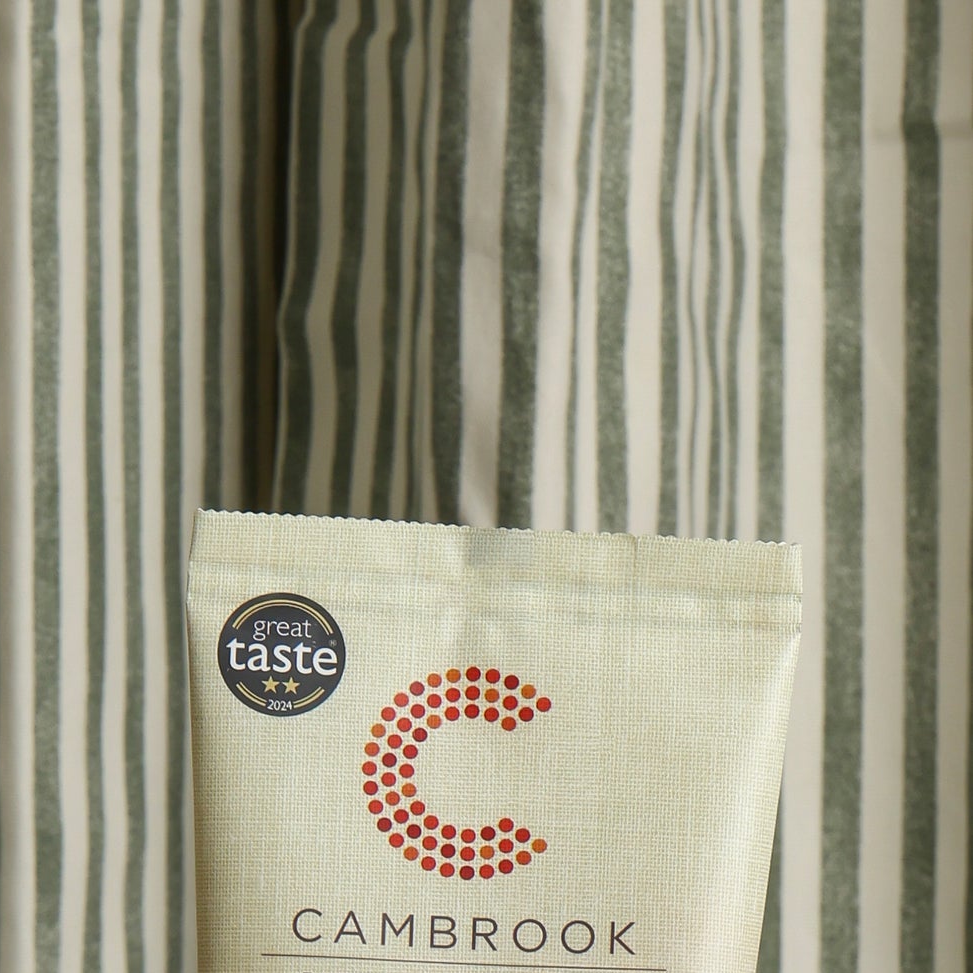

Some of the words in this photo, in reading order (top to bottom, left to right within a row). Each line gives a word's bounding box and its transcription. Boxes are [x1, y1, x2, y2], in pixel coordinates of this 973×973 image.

[252, 620, 312, 641] great
[226, 637, 338, 676] taste
[267, 699, 292, 711] 2024
[292, 908, 636, 956] CAMBROOK
